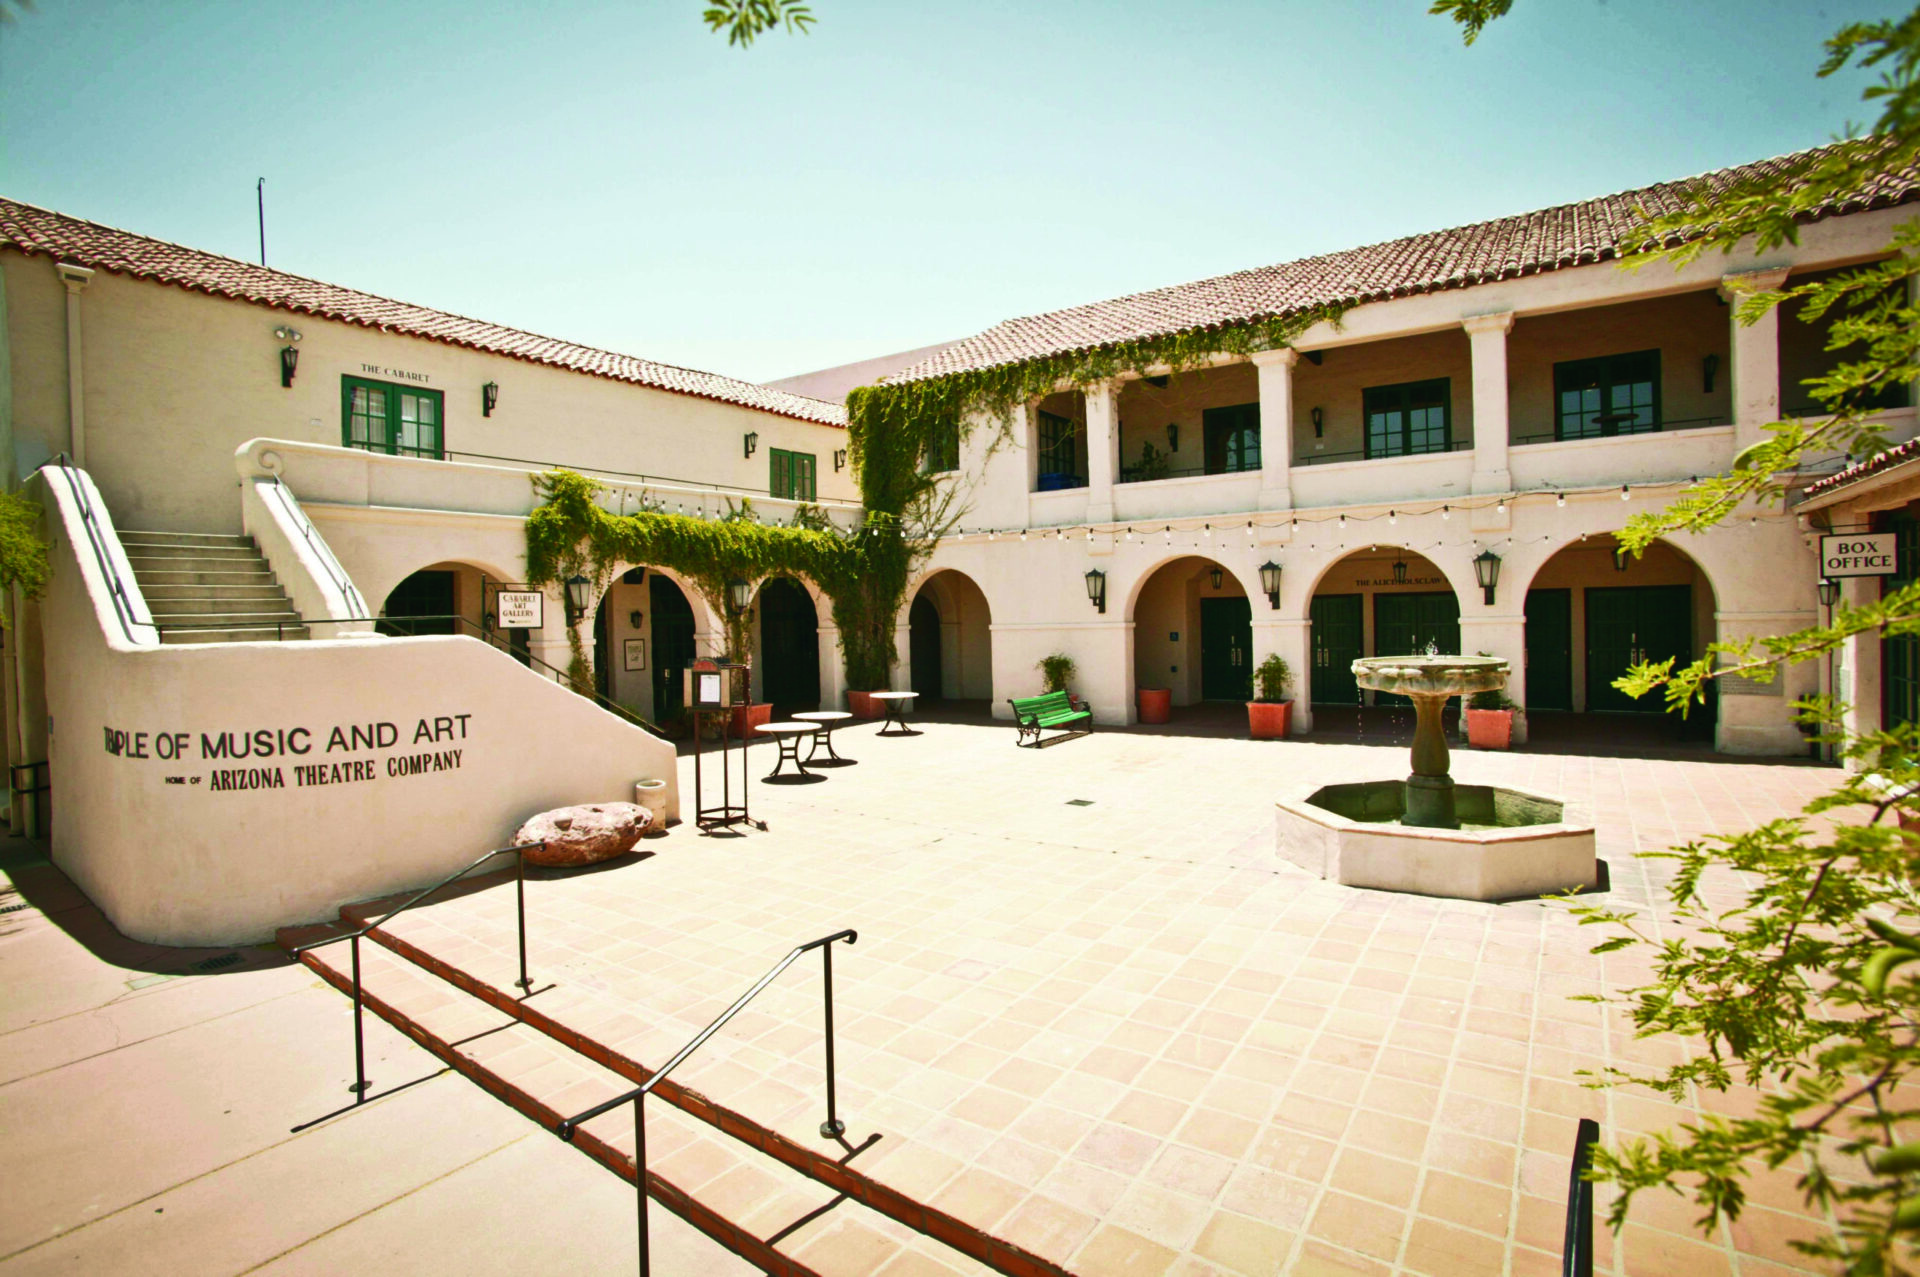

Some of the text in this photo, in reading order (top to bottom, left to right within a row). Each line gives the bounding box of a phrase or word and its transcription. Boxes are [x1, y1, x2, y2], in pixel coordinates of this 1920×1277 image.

[361, 363, 429, 382] THE CABARET
[1838, 541, 1878, 555] BOX
[1827, 555, 1892, 569] OFFICE
[1356, 579, 1370, 587] THE
[155, 731, 190, 760] OF
[200, 727, 312, 760] MUSIC
[325, 722, 399, 753] AND
[412, 713, 472, 745] ART
[165, 749, 462, 791] HOME OF ARIZONA THEATRE COMPANY
